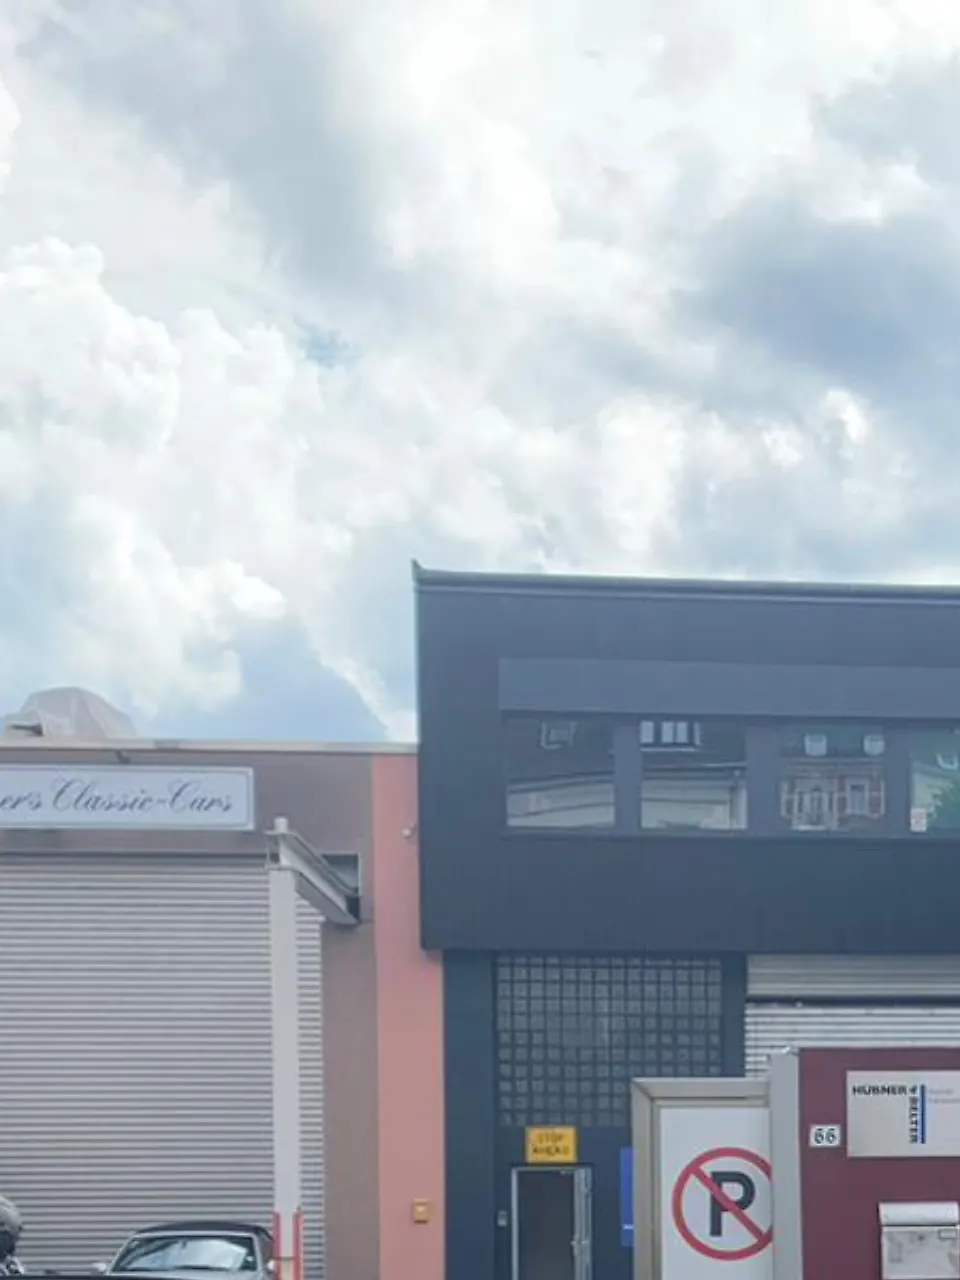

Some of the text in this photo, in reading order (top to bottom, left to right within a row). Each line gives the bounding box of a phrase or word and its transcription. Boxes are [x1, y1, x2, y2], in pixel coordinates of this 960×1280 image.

[51, 776, 233, 812] Classic-Cars
[813, 1127, 838, 1145] 66
[709, 1171, 755, 1237] P
